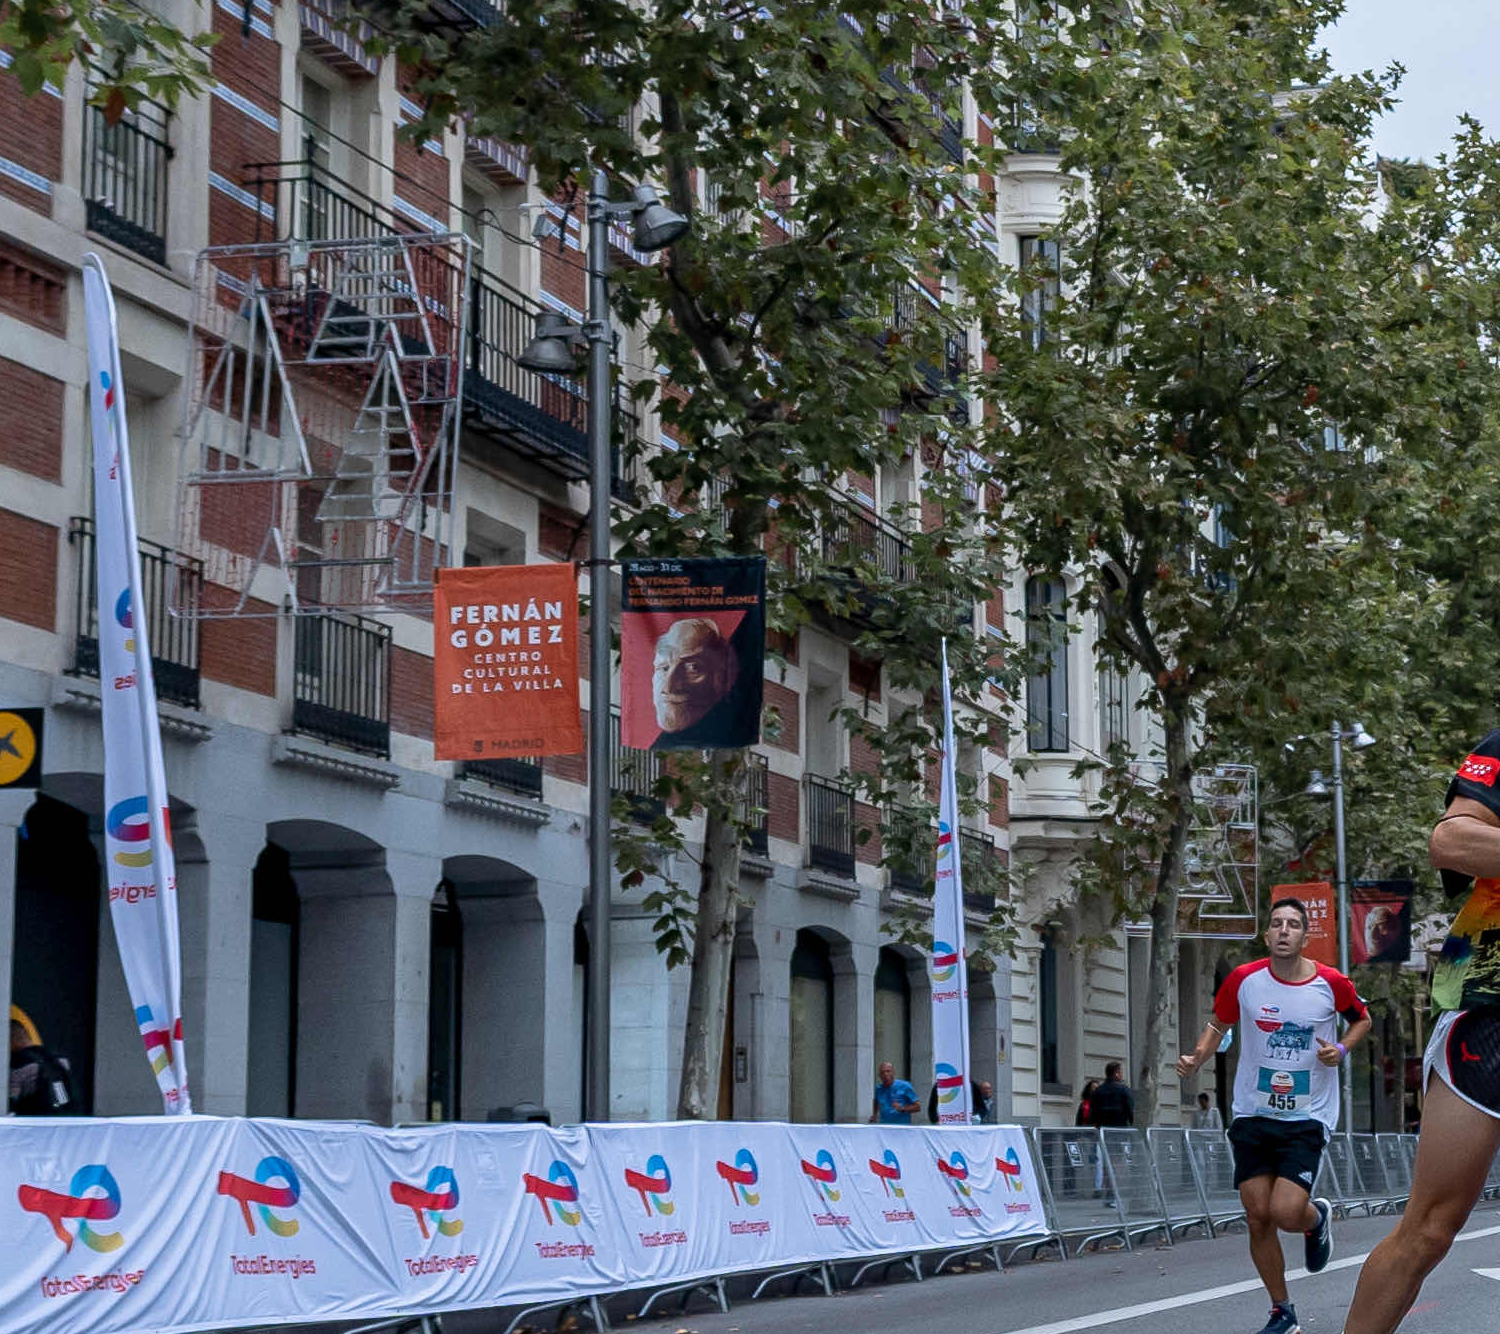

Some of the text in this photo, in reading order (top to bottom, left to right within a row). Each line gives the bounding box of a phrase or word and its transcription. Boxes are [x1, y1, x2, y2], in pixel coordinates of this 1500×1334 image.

[450, 597, 563, 624] FERNÁN
[450, 623, 563, 648] GÓMEZ
[474, 651, 542, 664] CENTRO
[463, 665, 551, 679] CULTURAL
[452, 678, 563, 694] DE LA VILLA
[1267, 1094, 1296, 1111] 455
[230, 1254, 317, 1279] TotalEnergies
